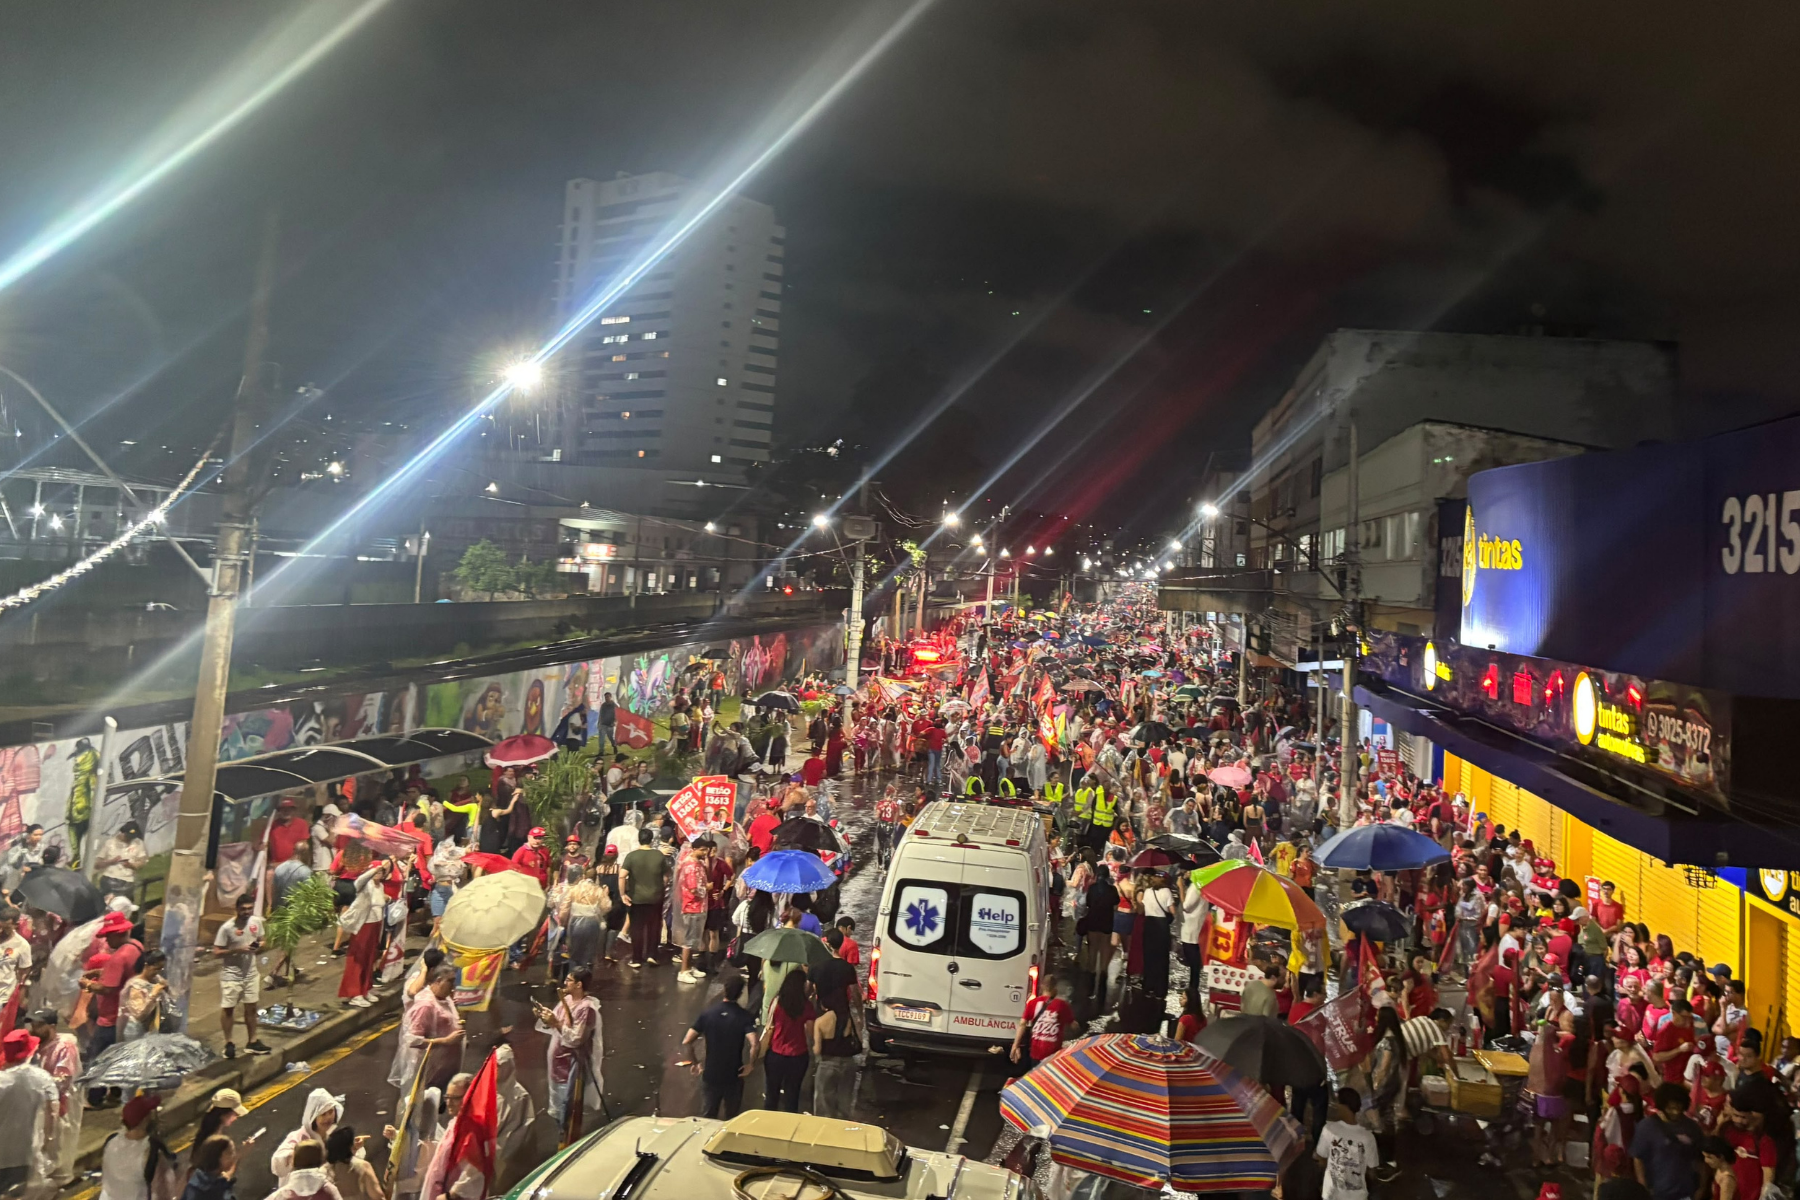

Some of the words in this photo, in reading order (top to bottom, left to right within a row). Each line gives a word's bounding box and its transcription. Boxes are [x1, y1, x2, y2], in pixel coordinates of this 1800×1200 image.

[1722, 490, 1800, 574] 3215
[1478, 532, 1523, 570] tintas
[1598, 701, 1630, 735] tintas
[677, 798, 699, 819] 13613
[705, 796, 730, 805] 13613
[981, 908, 1015, 925] Help
[1212, 926, 1232, 953] 13
